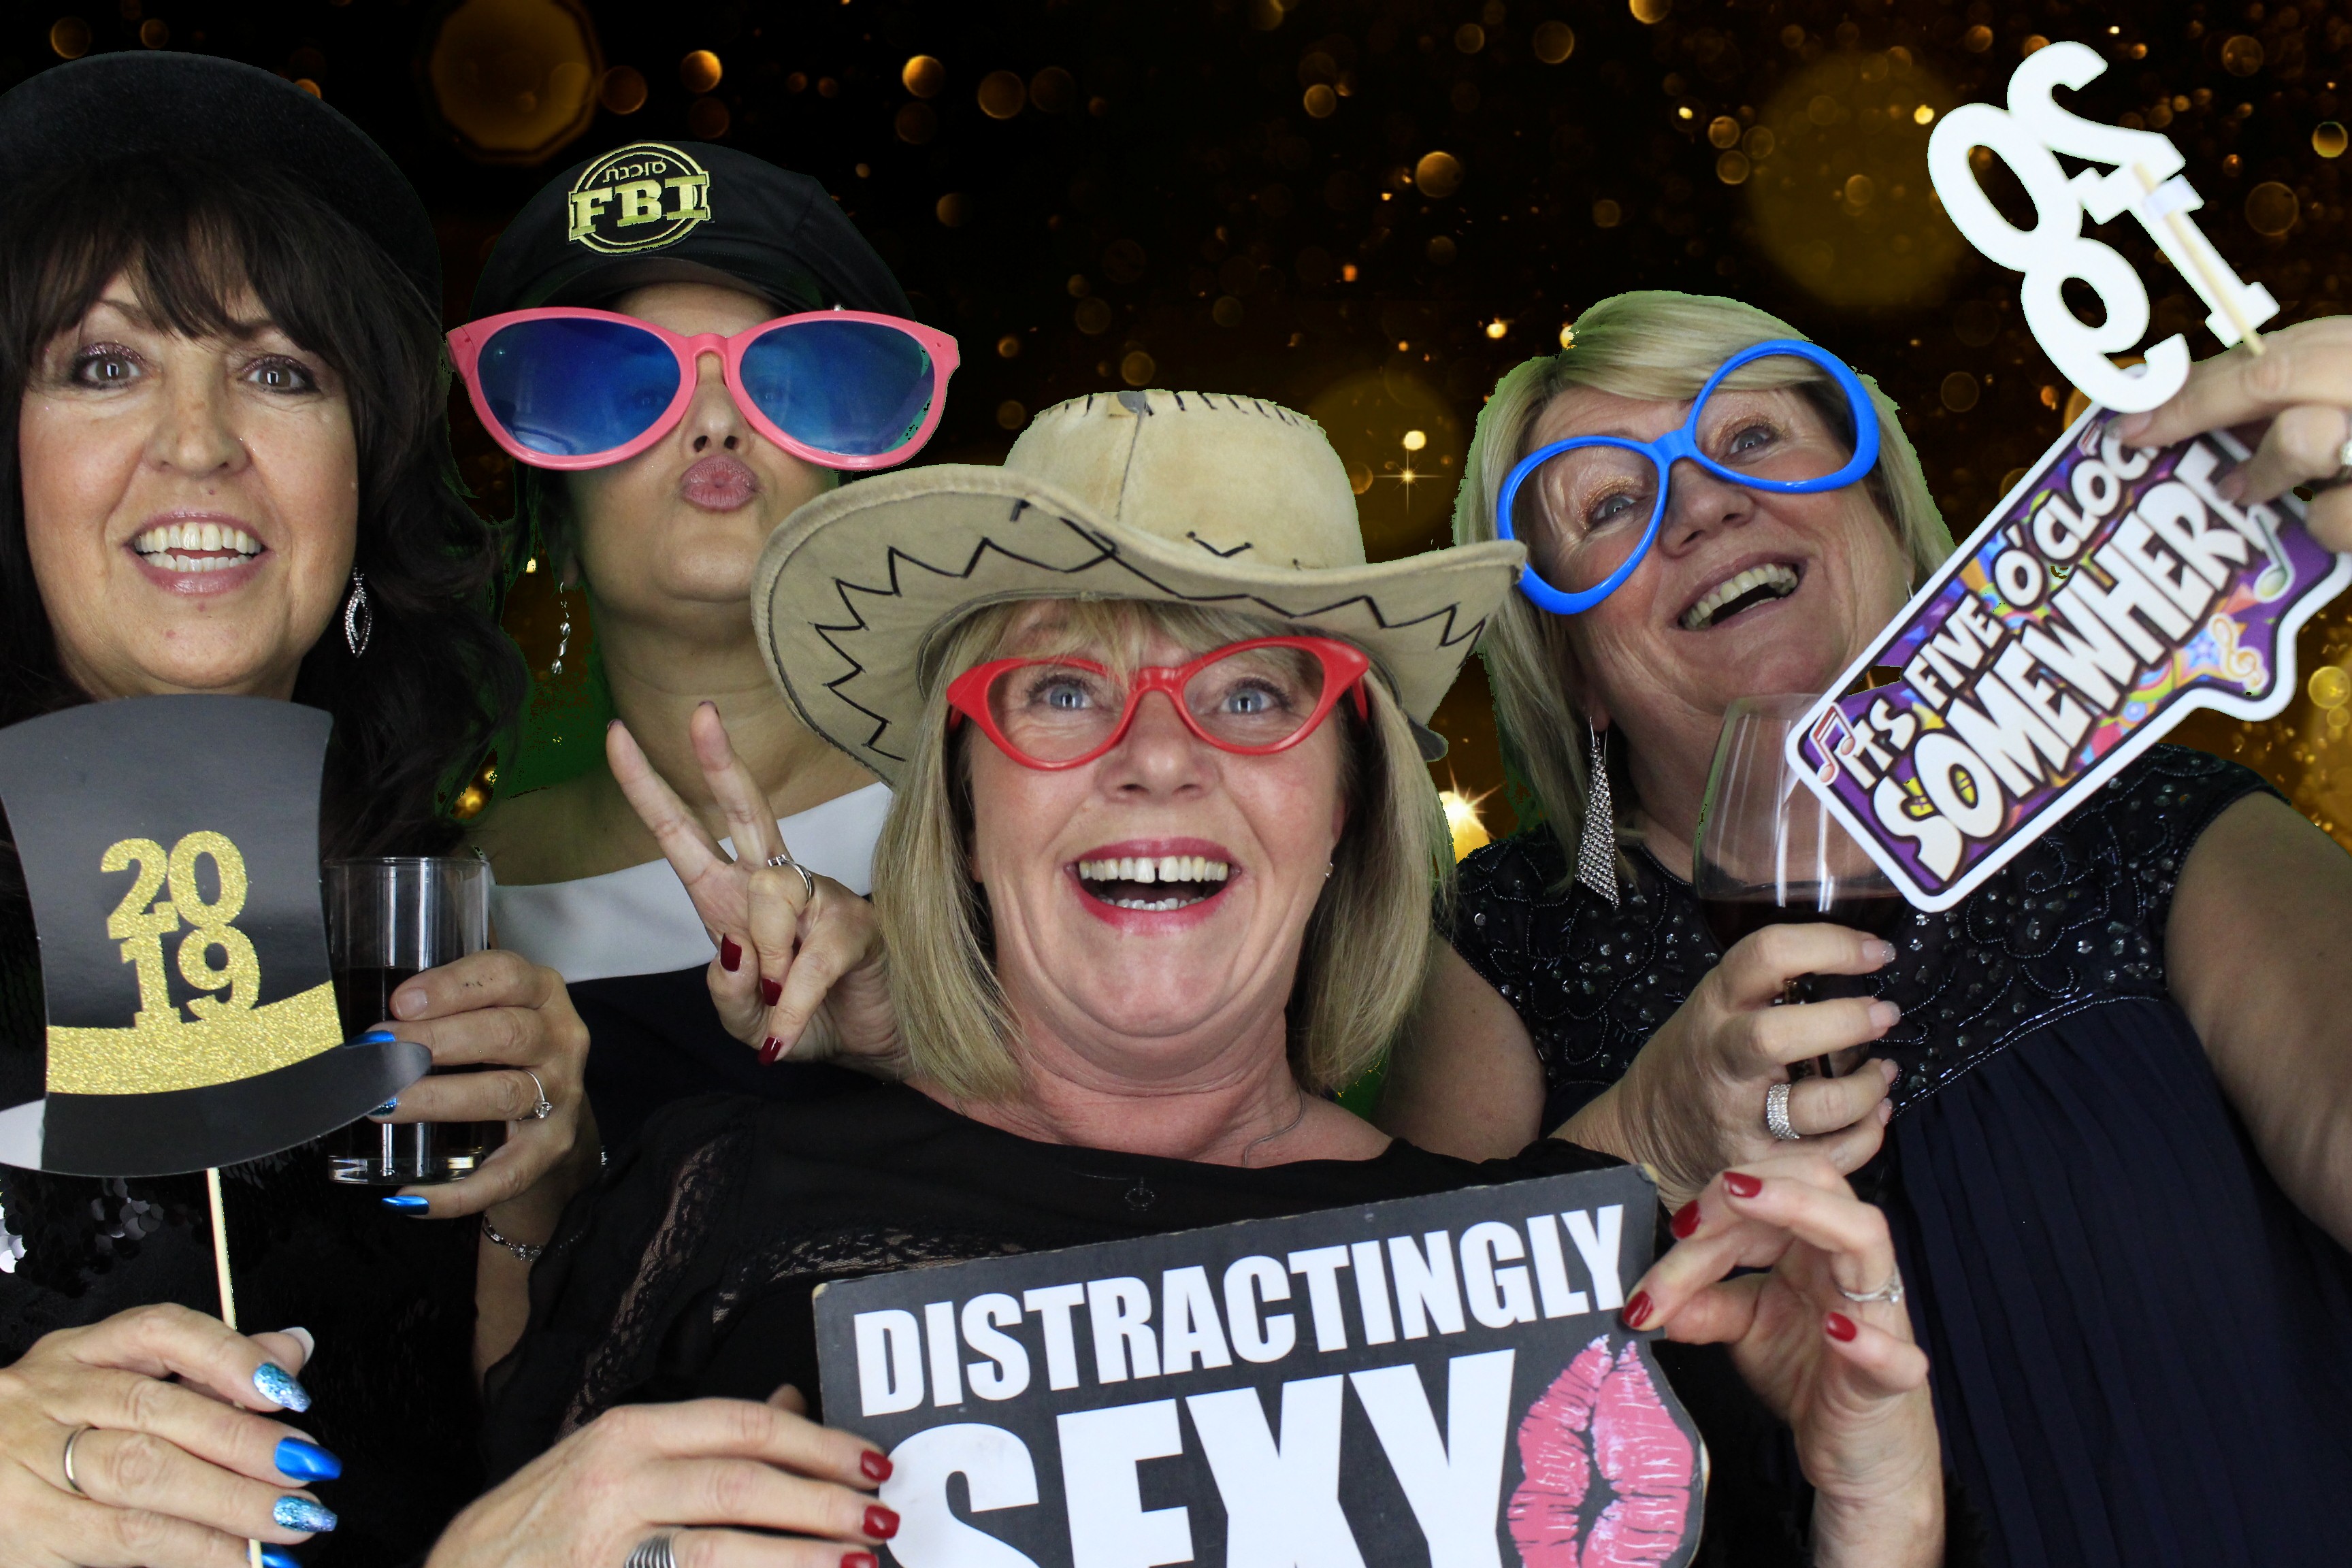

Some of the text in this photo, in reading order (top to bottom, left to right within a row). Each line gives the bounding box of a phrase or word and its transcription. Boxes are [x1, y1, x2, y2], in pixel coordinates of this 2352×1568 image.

[571, 174, 707, 238] FBI
[602, 161, 667, 183] סוכנת
[1903, 593, 2005, 710] FIVE
[1994, 436, 2159, 607] O'CLOC
[101, 830, 248, 939] 20
[120, 901, 261, 1029] 19
[853, 1204, 1625, 1418] DISTRACTINGLY
[878, 1349, 1516, 1568] SEXY
